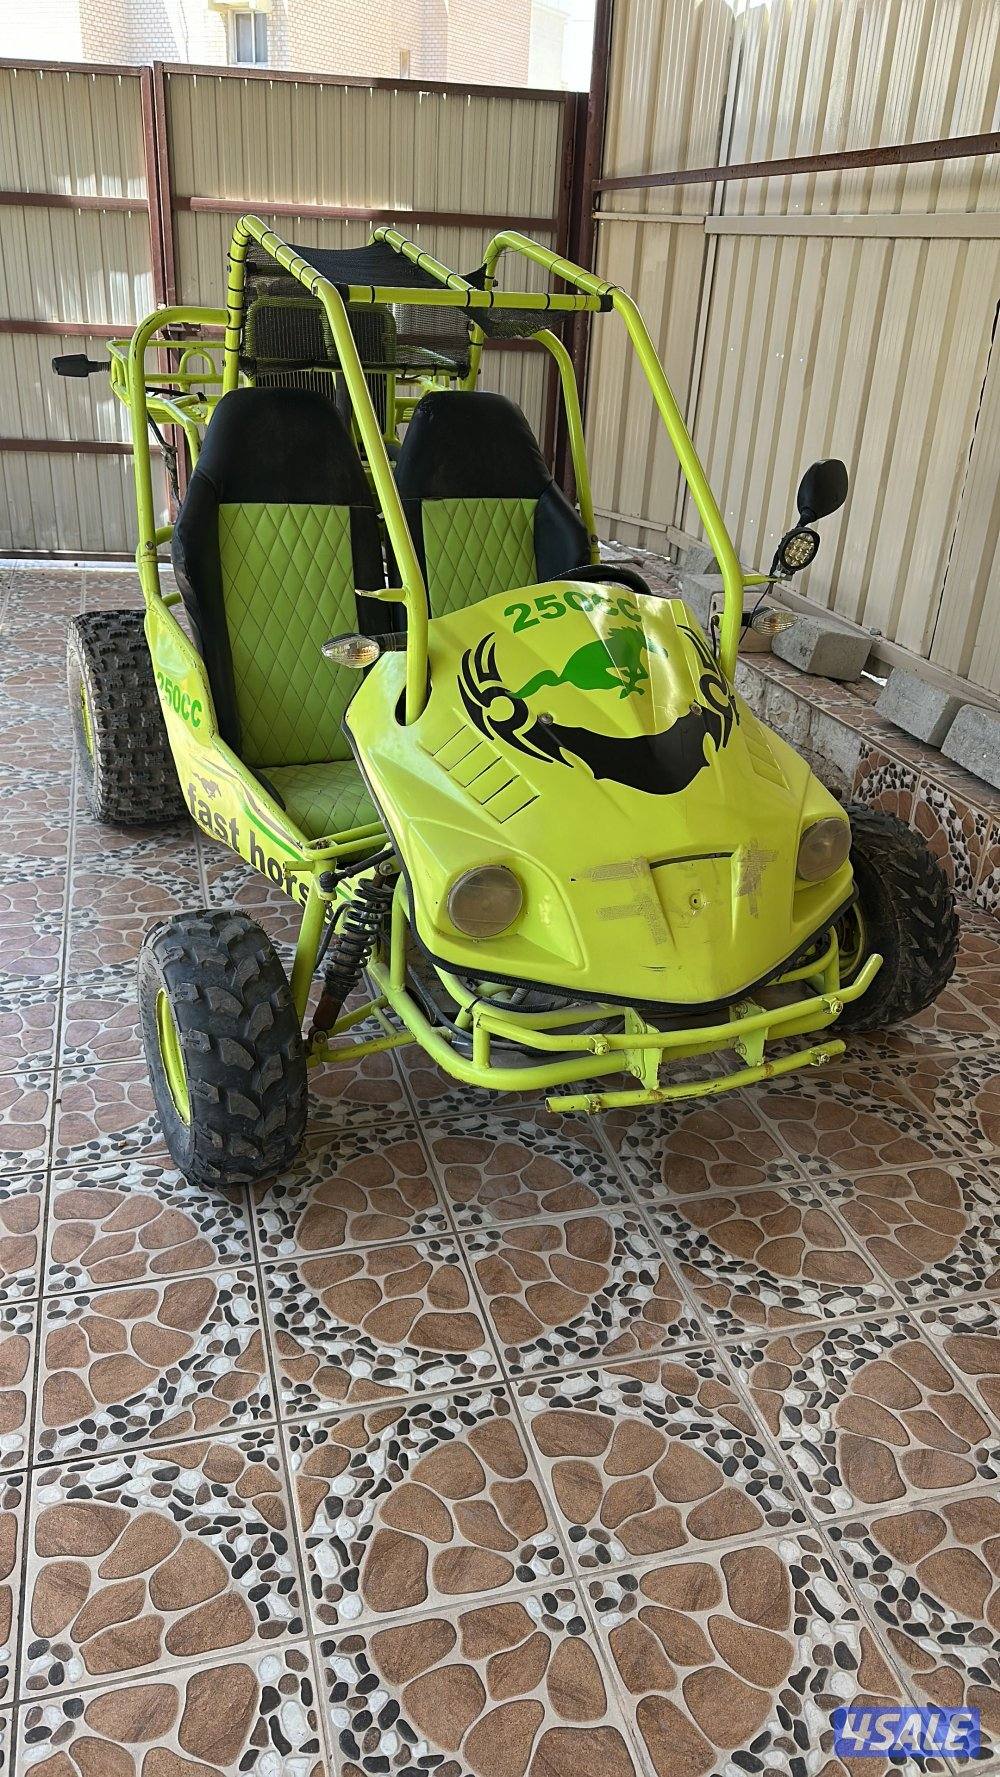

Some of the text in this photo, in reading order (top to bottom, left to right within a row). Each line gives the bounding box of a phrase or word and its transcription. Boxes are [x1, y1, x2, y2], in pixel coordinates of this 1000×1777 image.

[503, 591, 642, 634] 250CC
[156, 671, 203, 728] 250CC
[187, 782, 241, 854] fast
